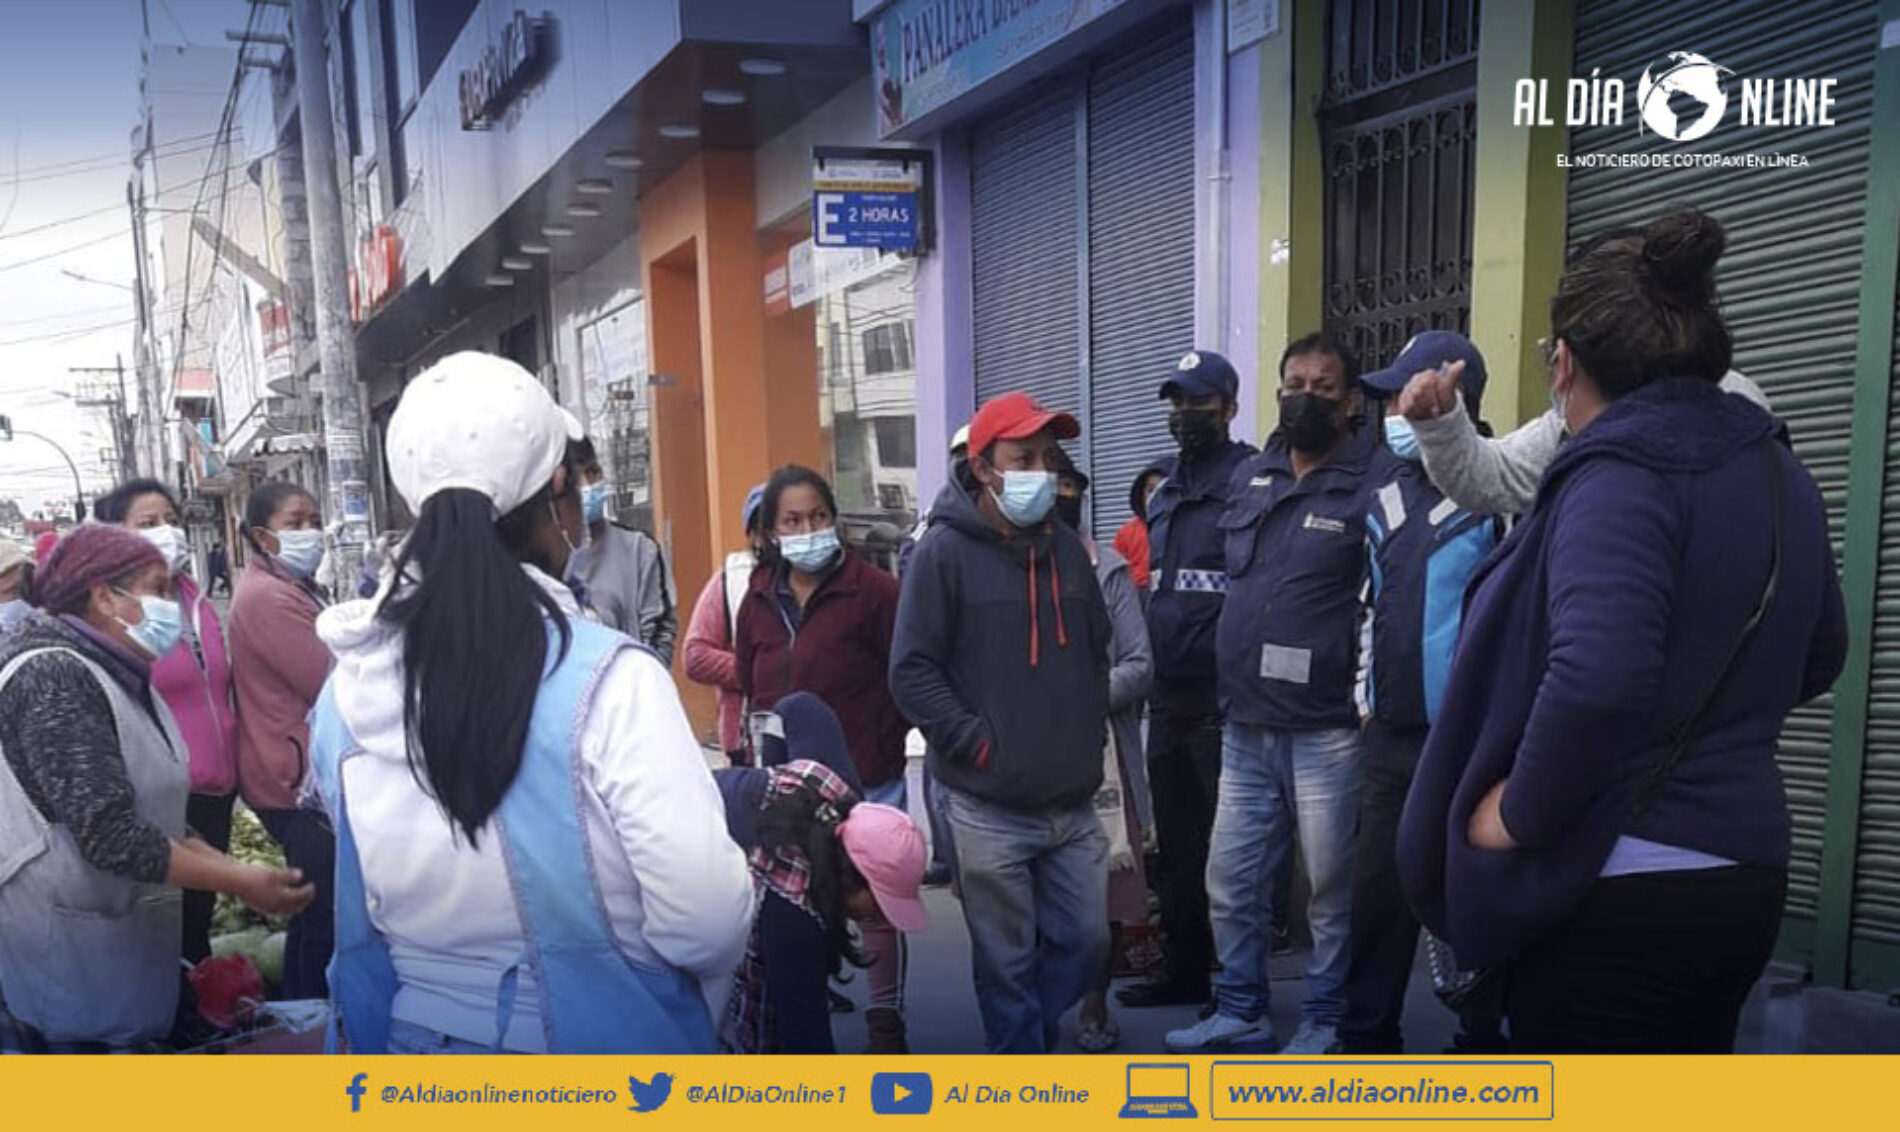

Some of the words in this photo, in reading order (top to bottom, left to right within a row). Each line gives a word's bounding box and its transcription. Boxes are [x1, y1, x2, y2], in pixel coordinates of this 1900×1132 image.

[816, 194, 847, 245] E
[848, 207, 858, 223] 2
[862, 207, 909, 224] HORAS
